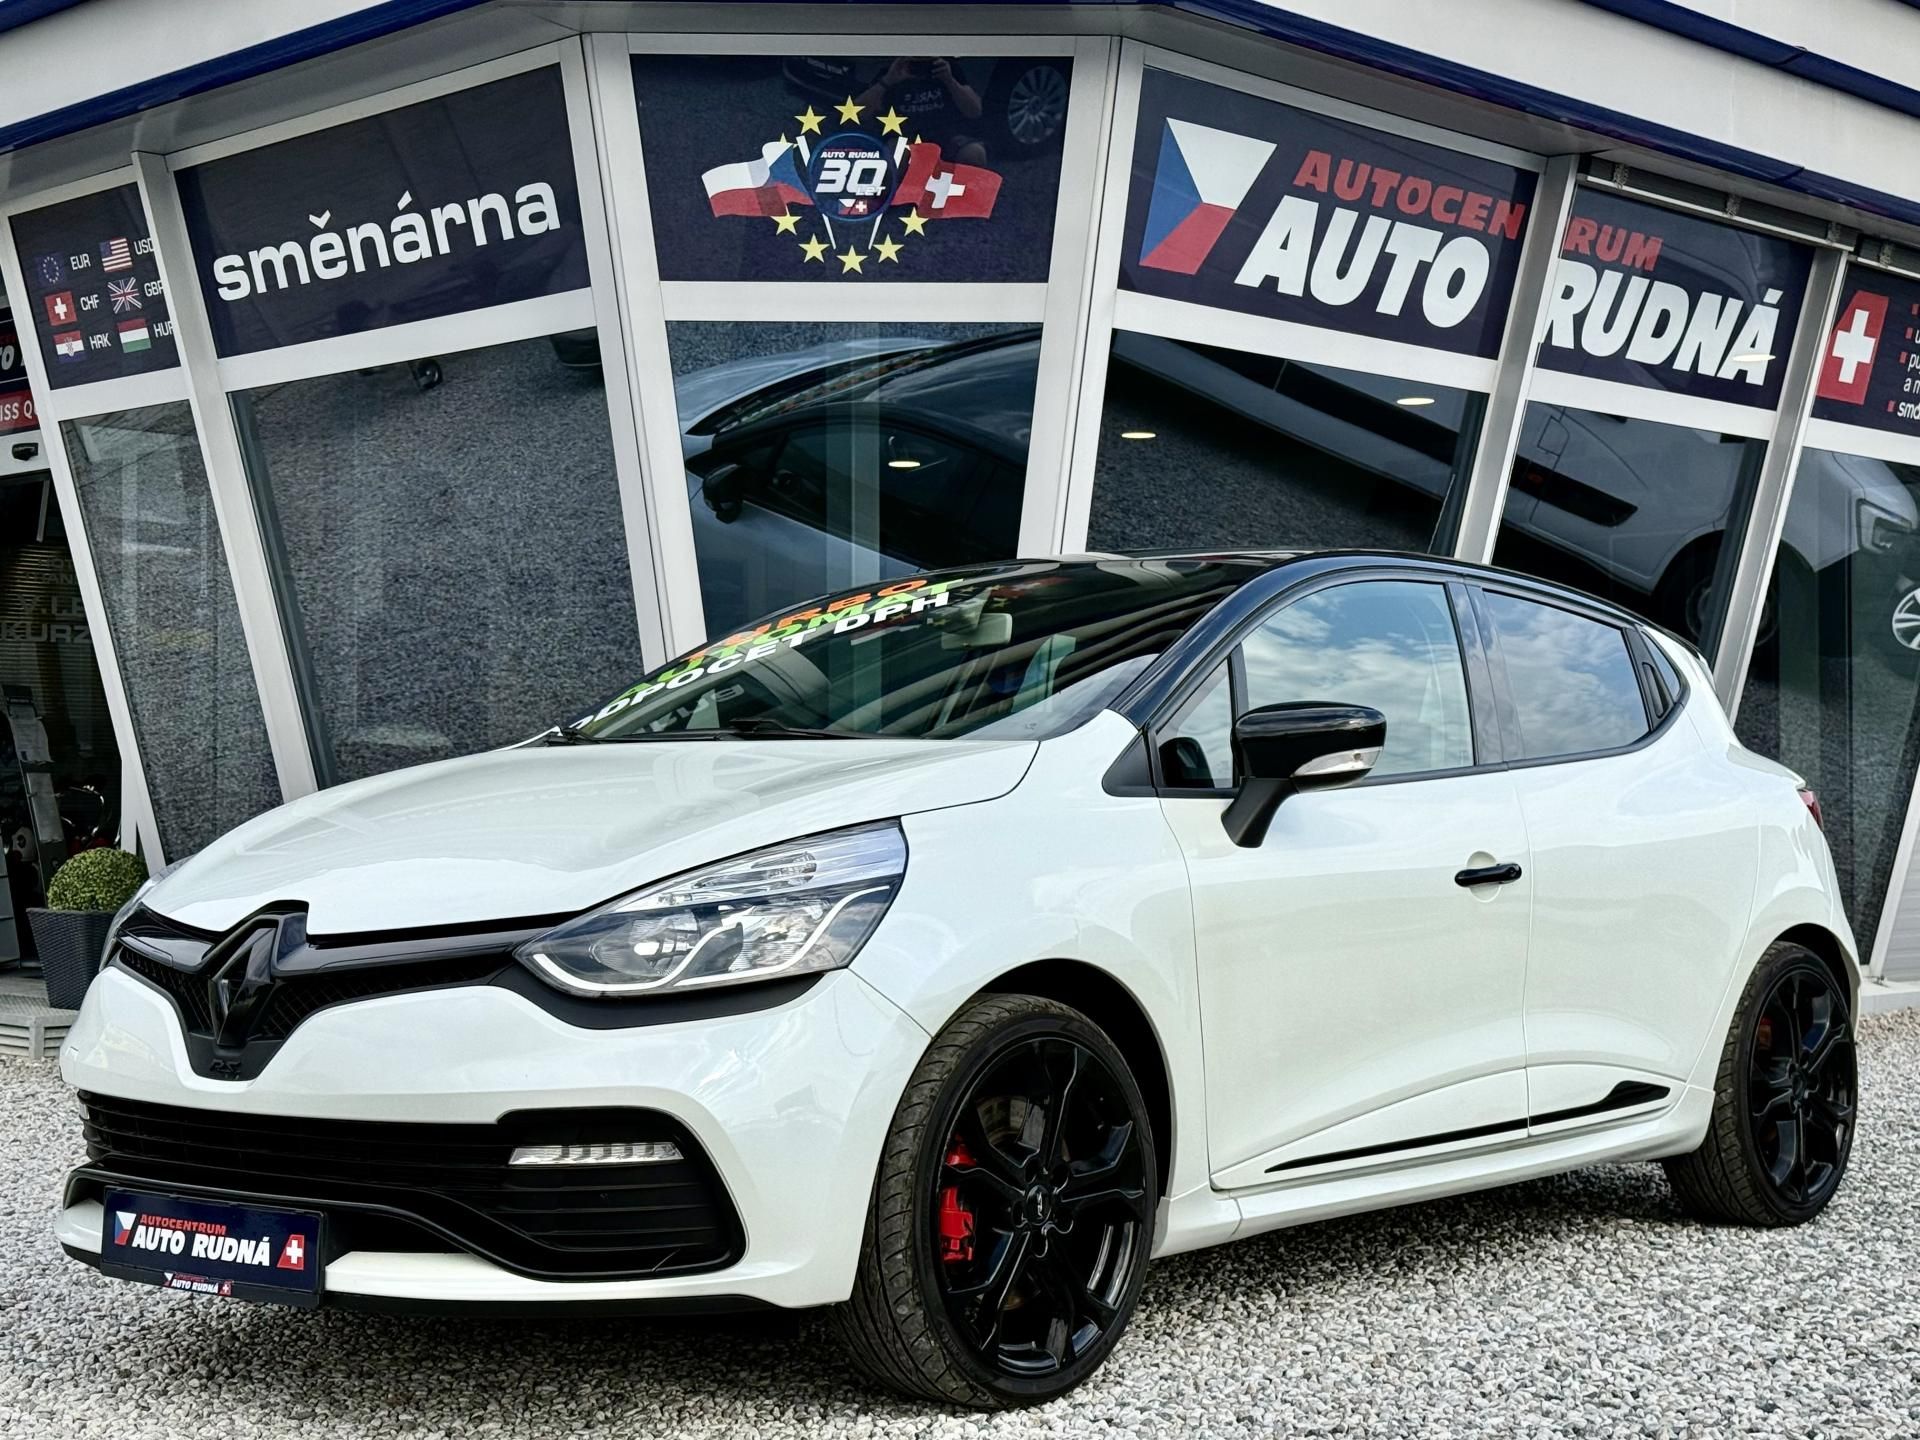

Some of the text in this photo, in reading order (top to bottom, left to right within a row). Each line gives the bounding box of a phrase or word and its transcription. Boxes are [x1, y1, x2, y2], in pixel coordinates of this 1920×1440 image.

[821, 151, 846, 159] AUTO
[815, 159, 888, 193] 30
[212, 182, 561, 301] směnárna
[70, 253, 91, 271] EUR
[1233, 195, 1784, 386] AUTO RUDNÁ
[80, 294, 100, 311] CHF
[89, 333, 112, 350] HRK
[834, 591, 949, 635] DPH
[139, 1214, 227, 1236] AUTOCENTRUM
[132, 1225, 271, 1267] AUTO RUDNÁ
[171, 1279, 219, 1294] AUTO RUDNÁ
